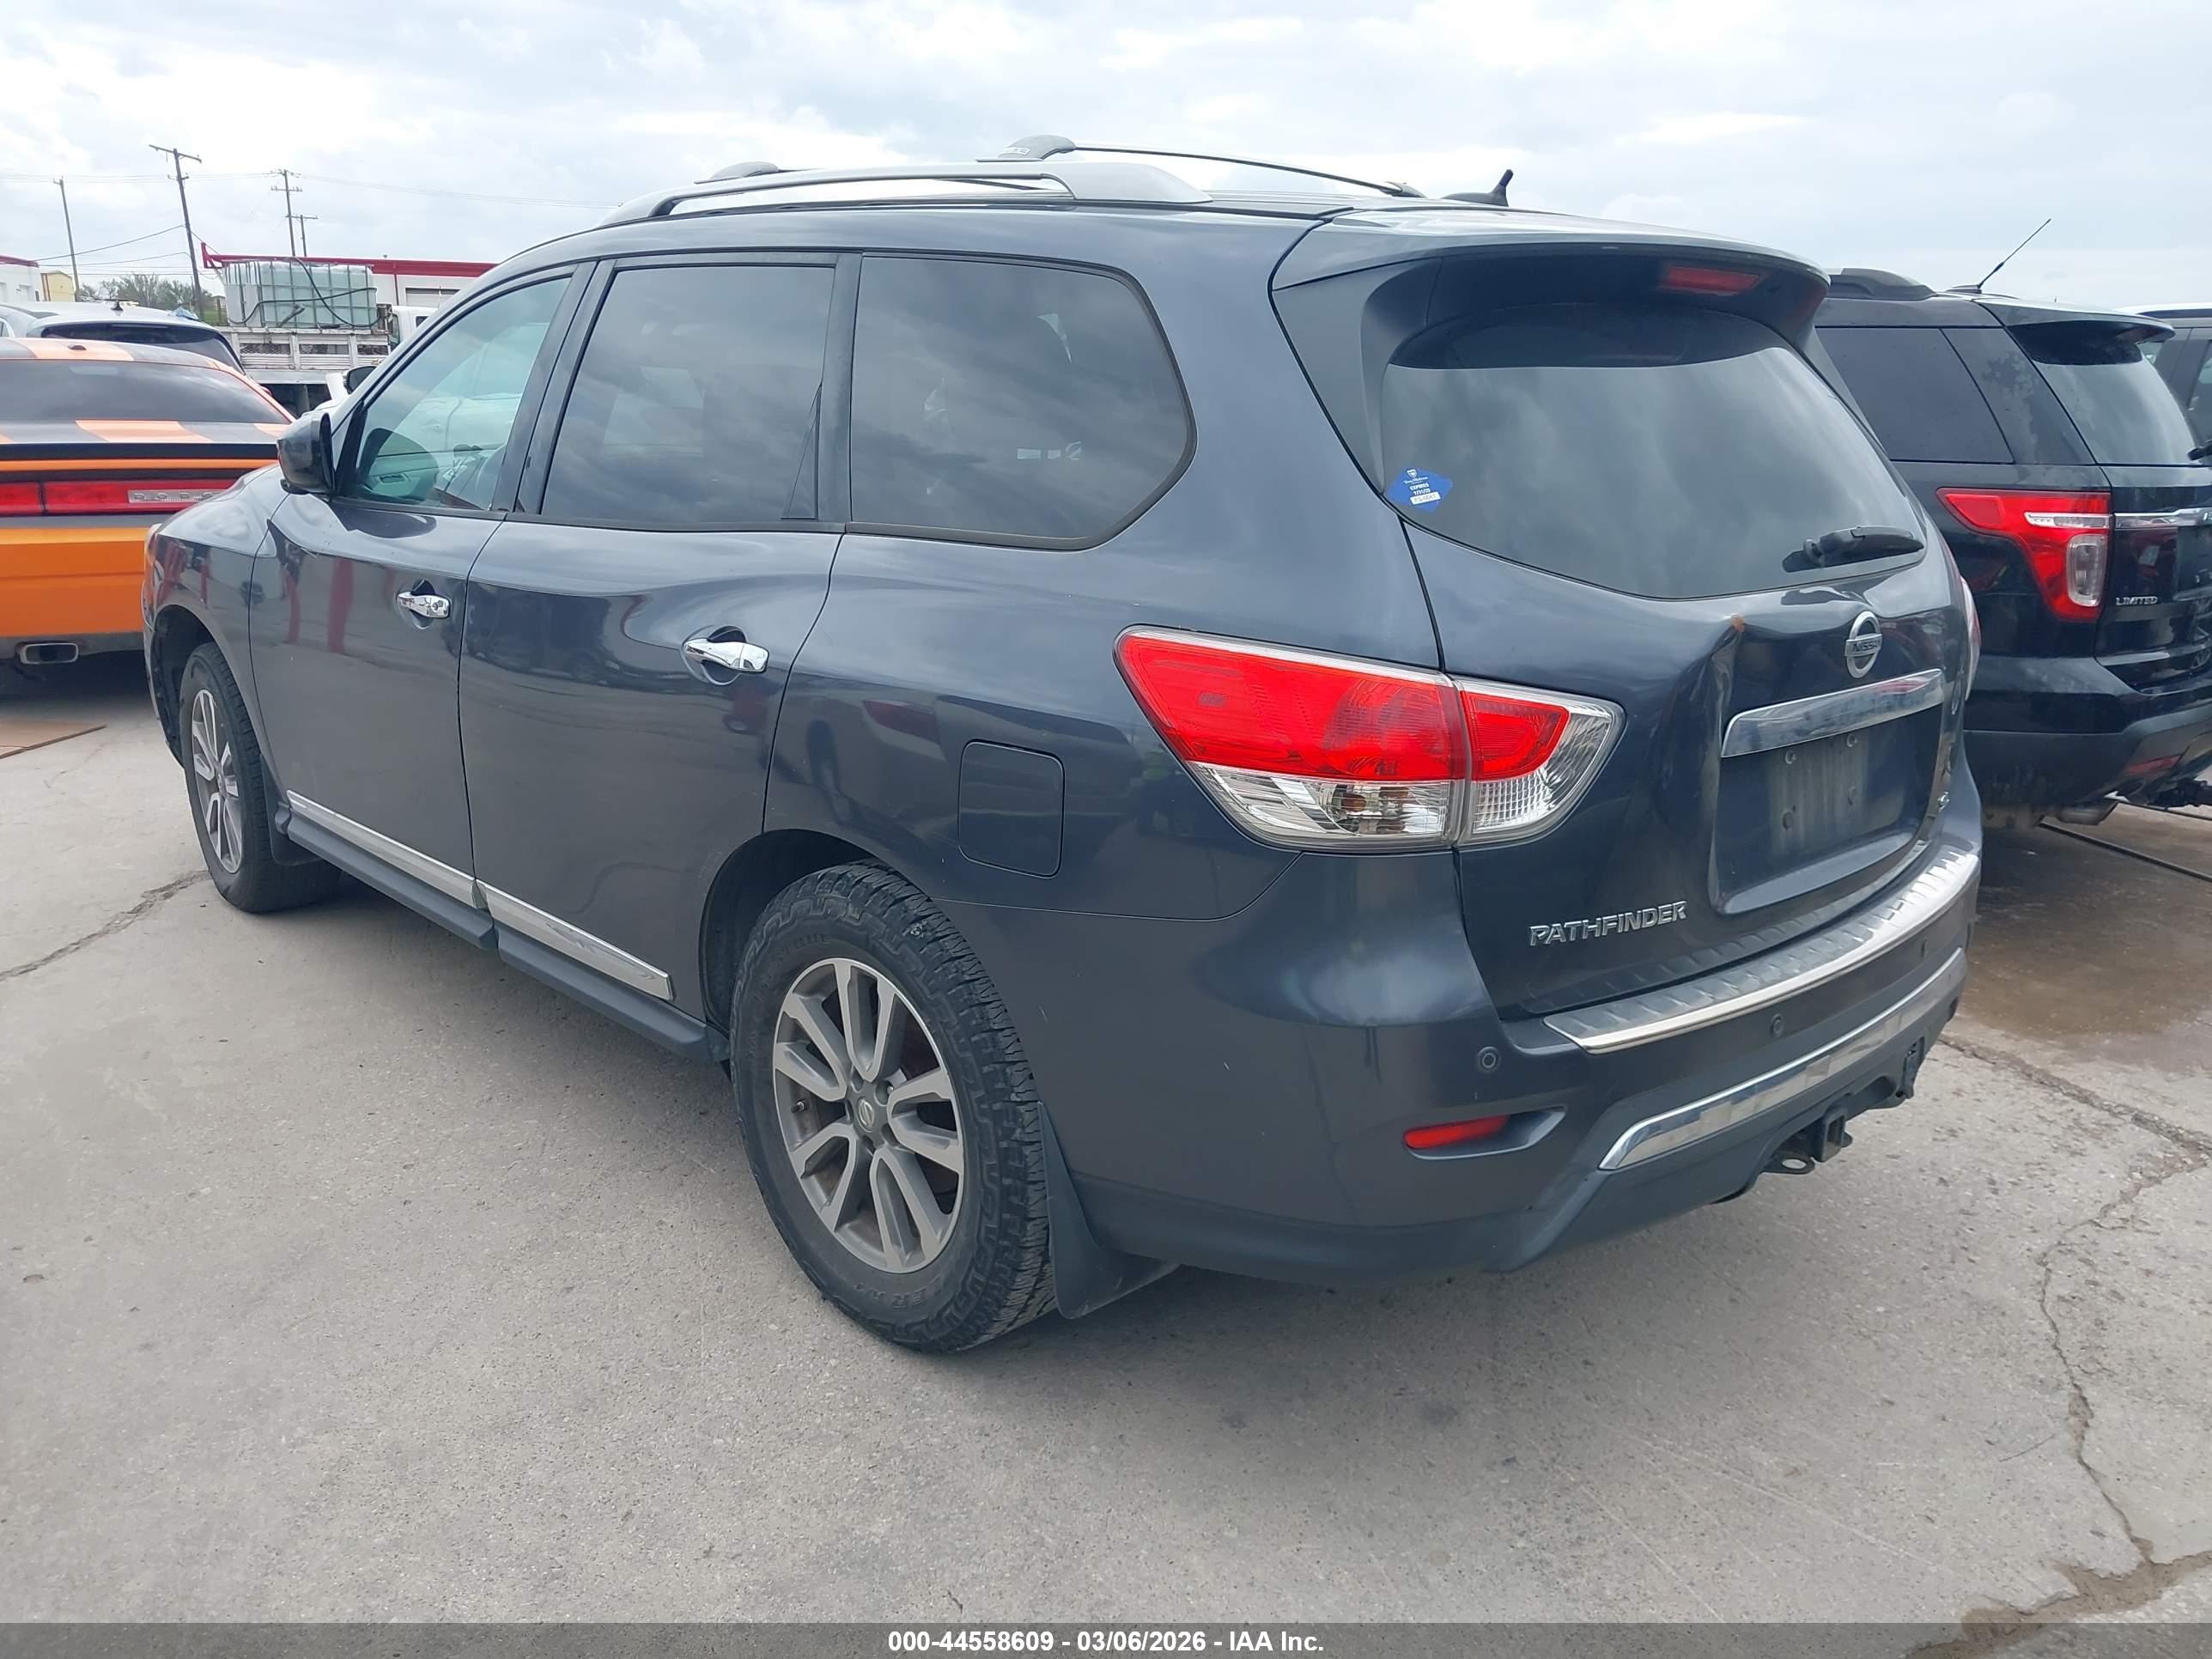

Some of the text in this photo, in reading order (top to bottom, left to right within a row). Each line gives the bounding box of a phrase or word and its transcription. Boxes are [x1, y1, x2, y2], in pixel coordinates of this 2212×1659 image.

[2115, 596, 2158, 606] LIMITED
[1853, 638, 1881, 653] NISSAN
[1528, 900, 1689, 946] PATHFINDER
